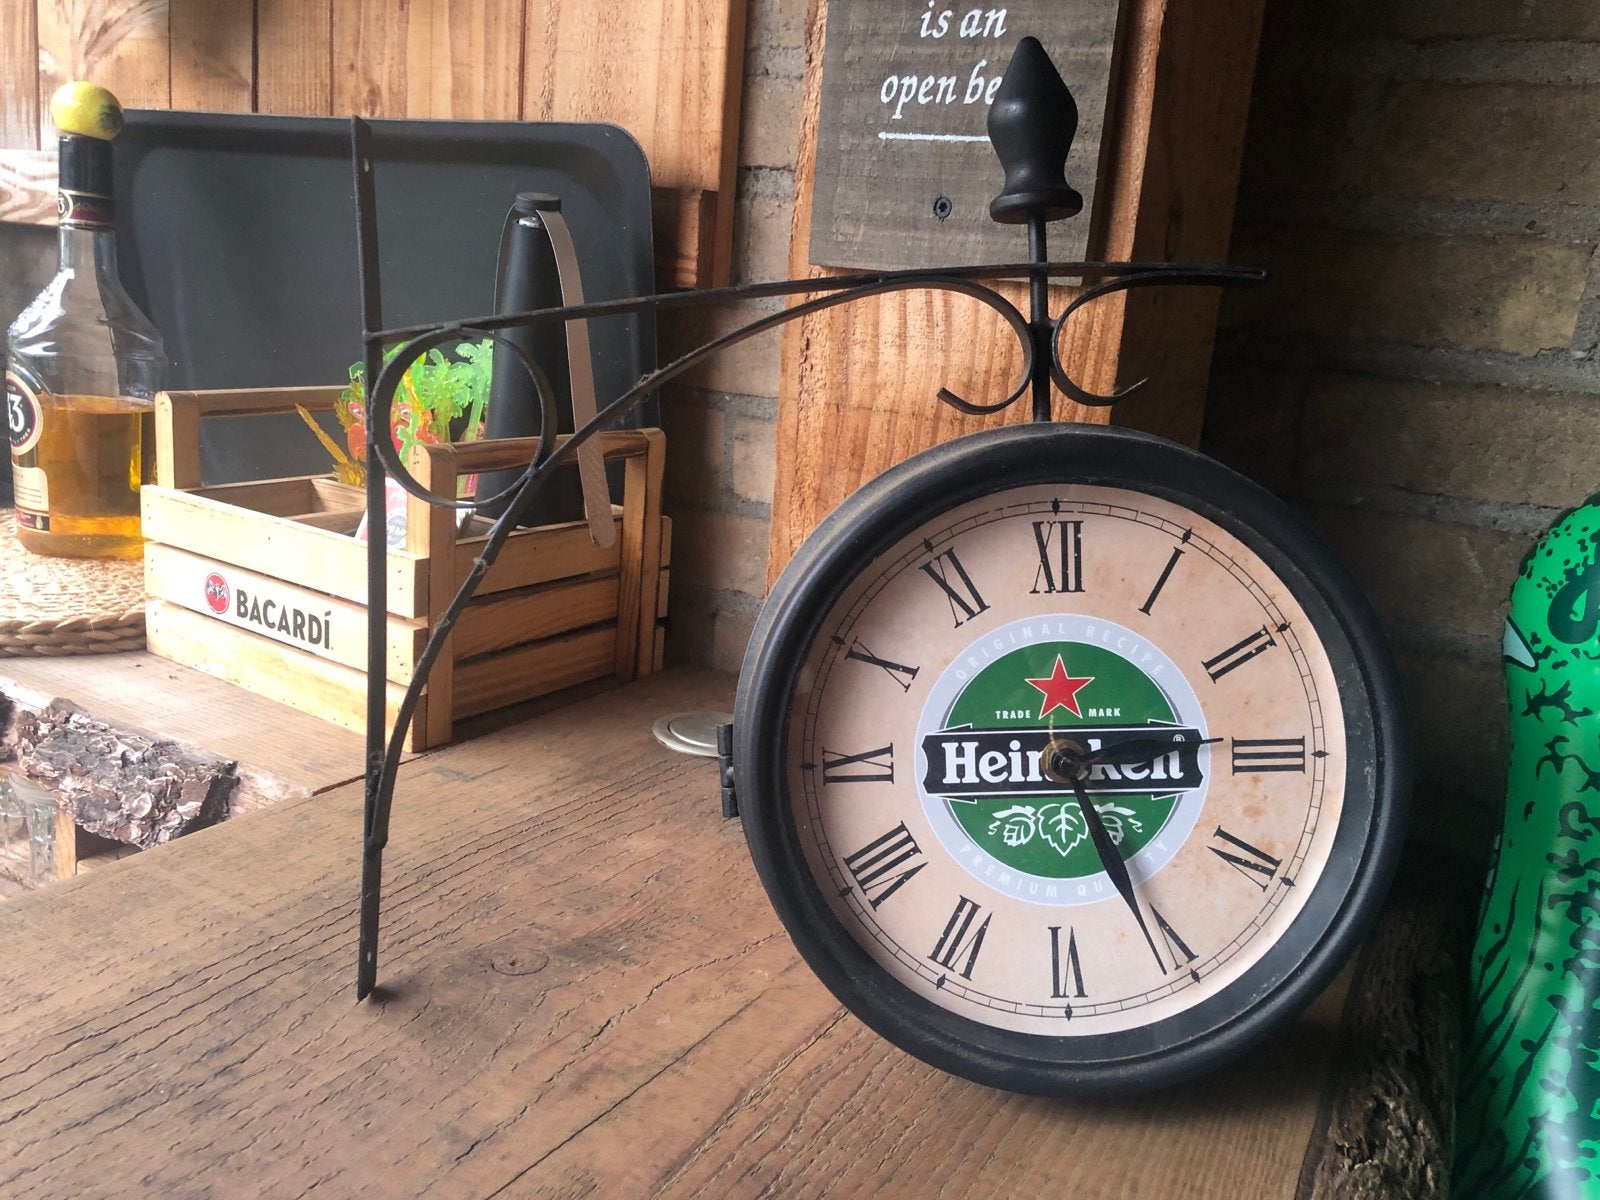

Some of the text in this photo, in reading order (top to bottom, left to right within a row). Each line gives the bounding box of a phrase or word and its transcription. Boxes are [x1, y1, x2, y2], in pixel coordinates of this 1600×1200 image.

[920, 0, 1007, 38] is an
[880, 59, 1003, 119] open be
[1029, 520, 1086, 594] XII
[918, 547, 991, 629] XI
[236, 588, 332, 650] BACARDÍ
[845, 636, 920, 693] X
[955, 622, 1164, 681] ORIGINAL RECIPE
[995, 707, 1121, 719] TRADE MARK
[941, 739, 1185, 784] Heinken
[1231, 735, 1306, 776] III
[958, 842, 1168, 898] PREMIUM QUITY
